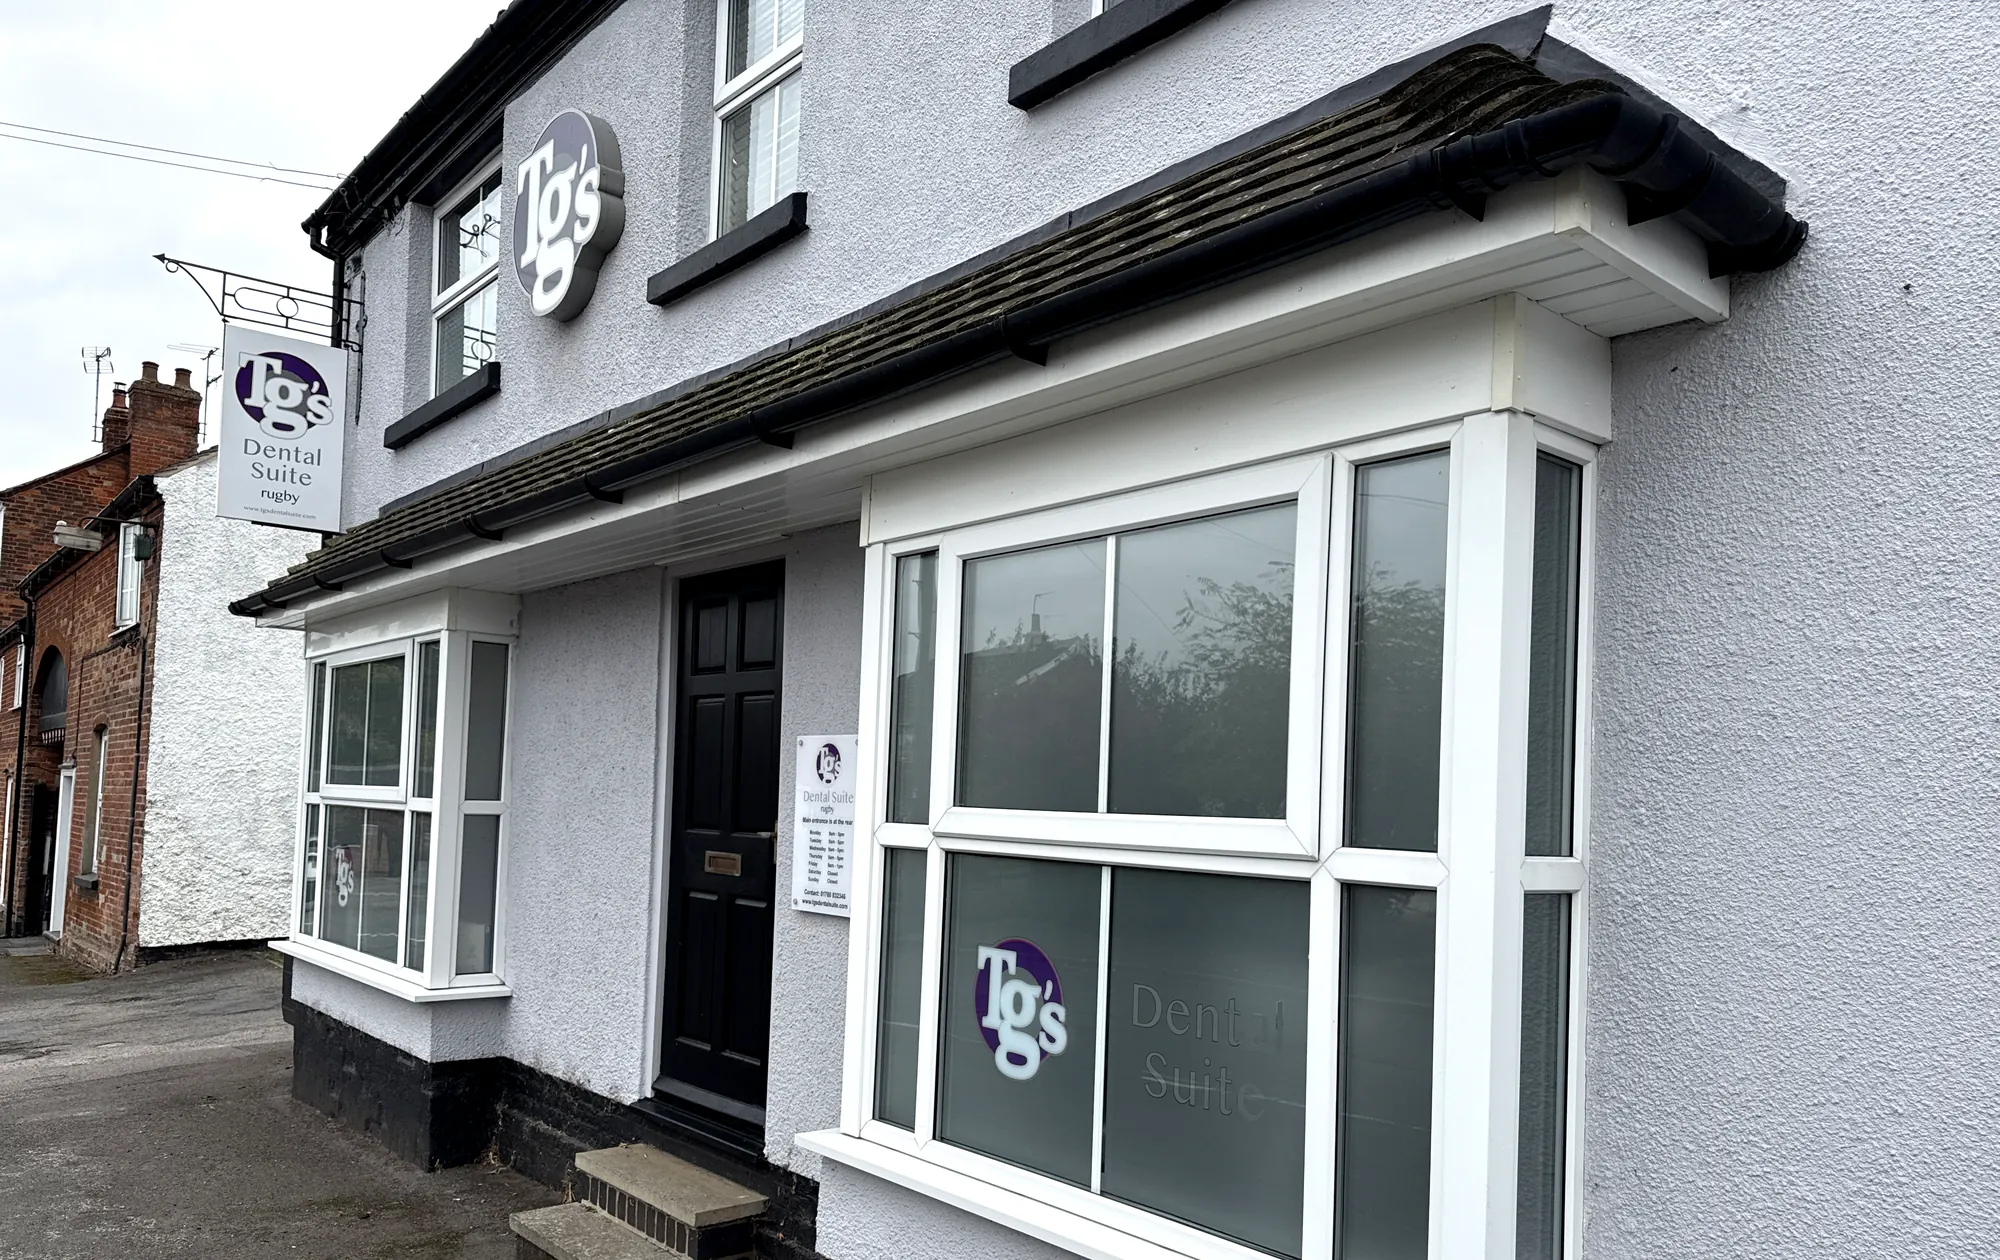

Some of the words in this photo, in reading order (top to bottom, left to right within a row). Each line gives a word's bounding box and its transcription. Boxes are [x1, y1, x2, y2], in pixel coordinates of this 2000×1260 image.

[517, 138, 600, 314] Tg's
[238, 351, 334, 440] Tg's
[243, 438, 321, 466] Dental
[251, 461, 312, 486] Suite
[261, 489, 300, 505] rugby
[818, 747, 843, 788] Tg's
[803, 790, 830, 803] Dental
[831, 790, 854, 804] Suite
[820, 805, 834, 815] rugby
[808, 860, 818, 868] Friday
[977, 945, 1068, 1080] Tg's
[1144, 1051, 1264, 1123] Suite
